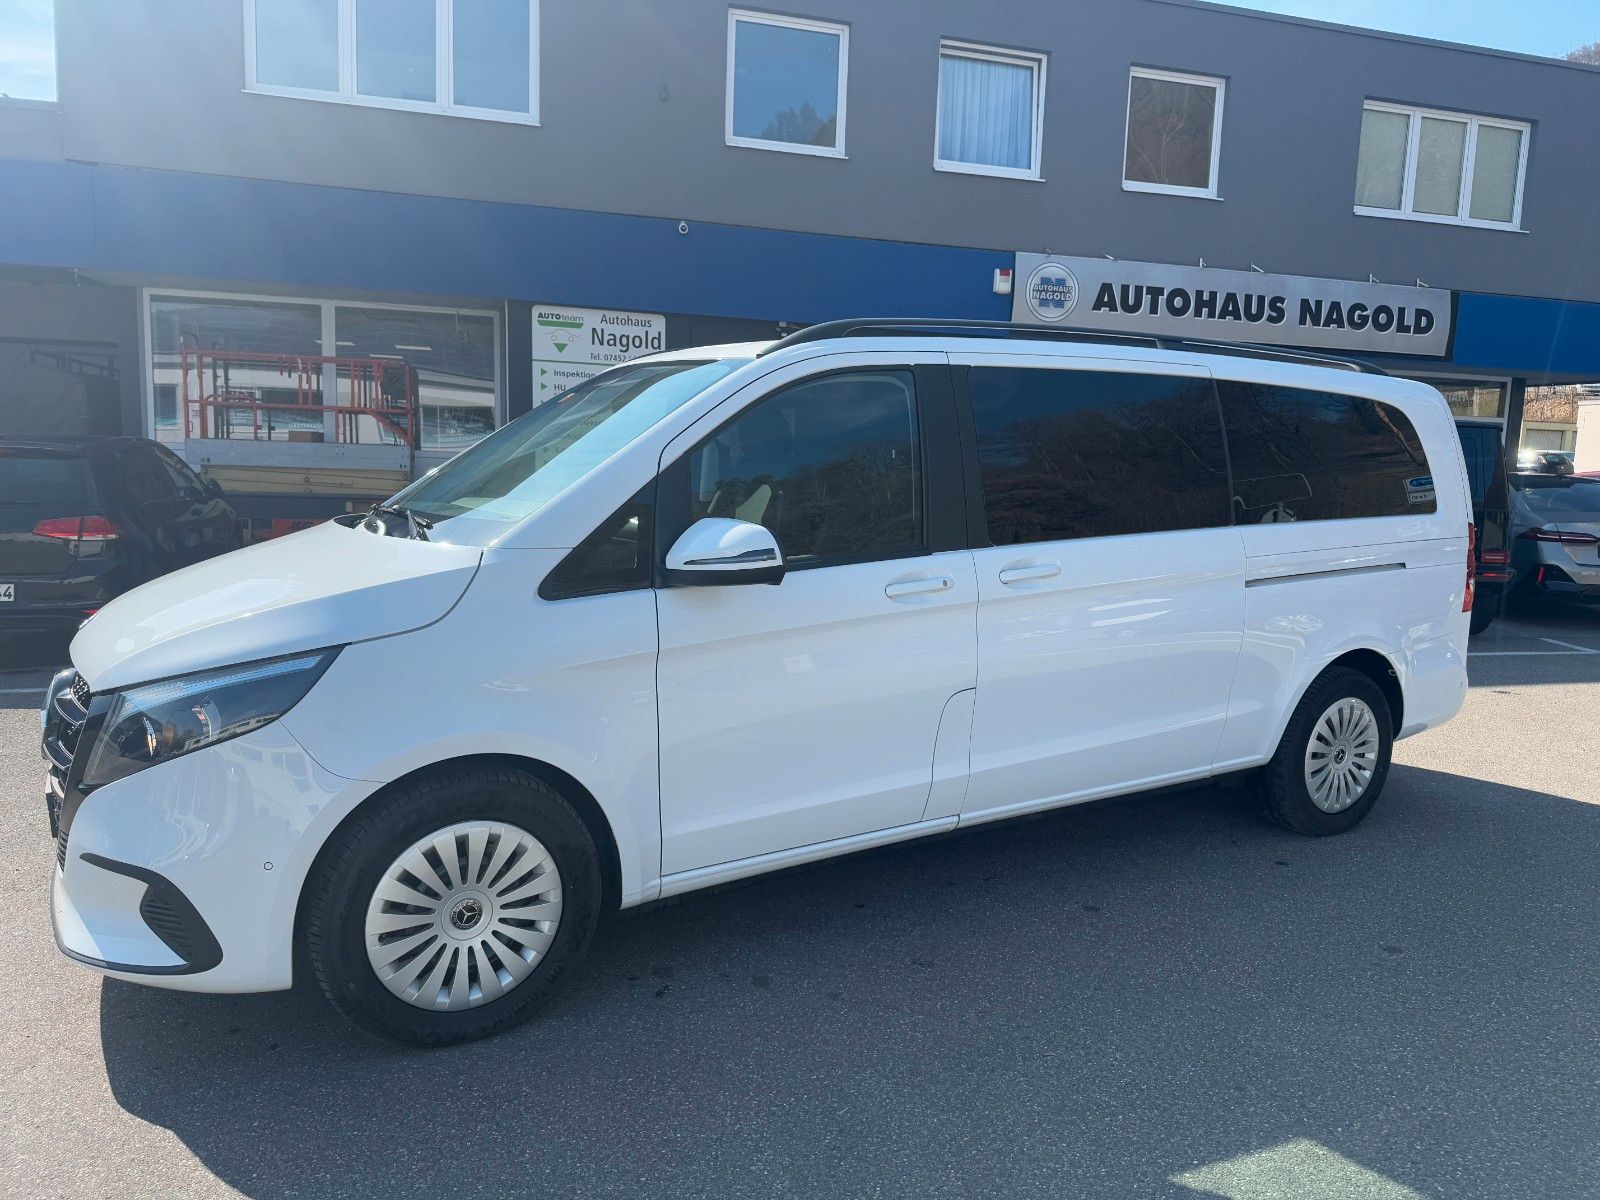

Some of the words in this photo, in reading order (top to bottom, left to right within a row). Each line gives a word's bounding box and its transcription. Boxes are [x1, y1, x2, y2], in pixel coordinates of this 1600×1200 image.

[1033, 284, 1073, 293] AUTOHAUS
[1032, 291, 1073, 301] NAGOLD
[1092, 282, 1287, 325] AUTOHAUS
[1298, 298, 1436, 336] NAGOLD
[600, 314, 652, 328] Autohaus
[591, 327, 662, 353] Nagold
[590, 353, 602, 361] Tel.
[553, 383, 566, 391] HU
[0, 586, 12, 599] 4
